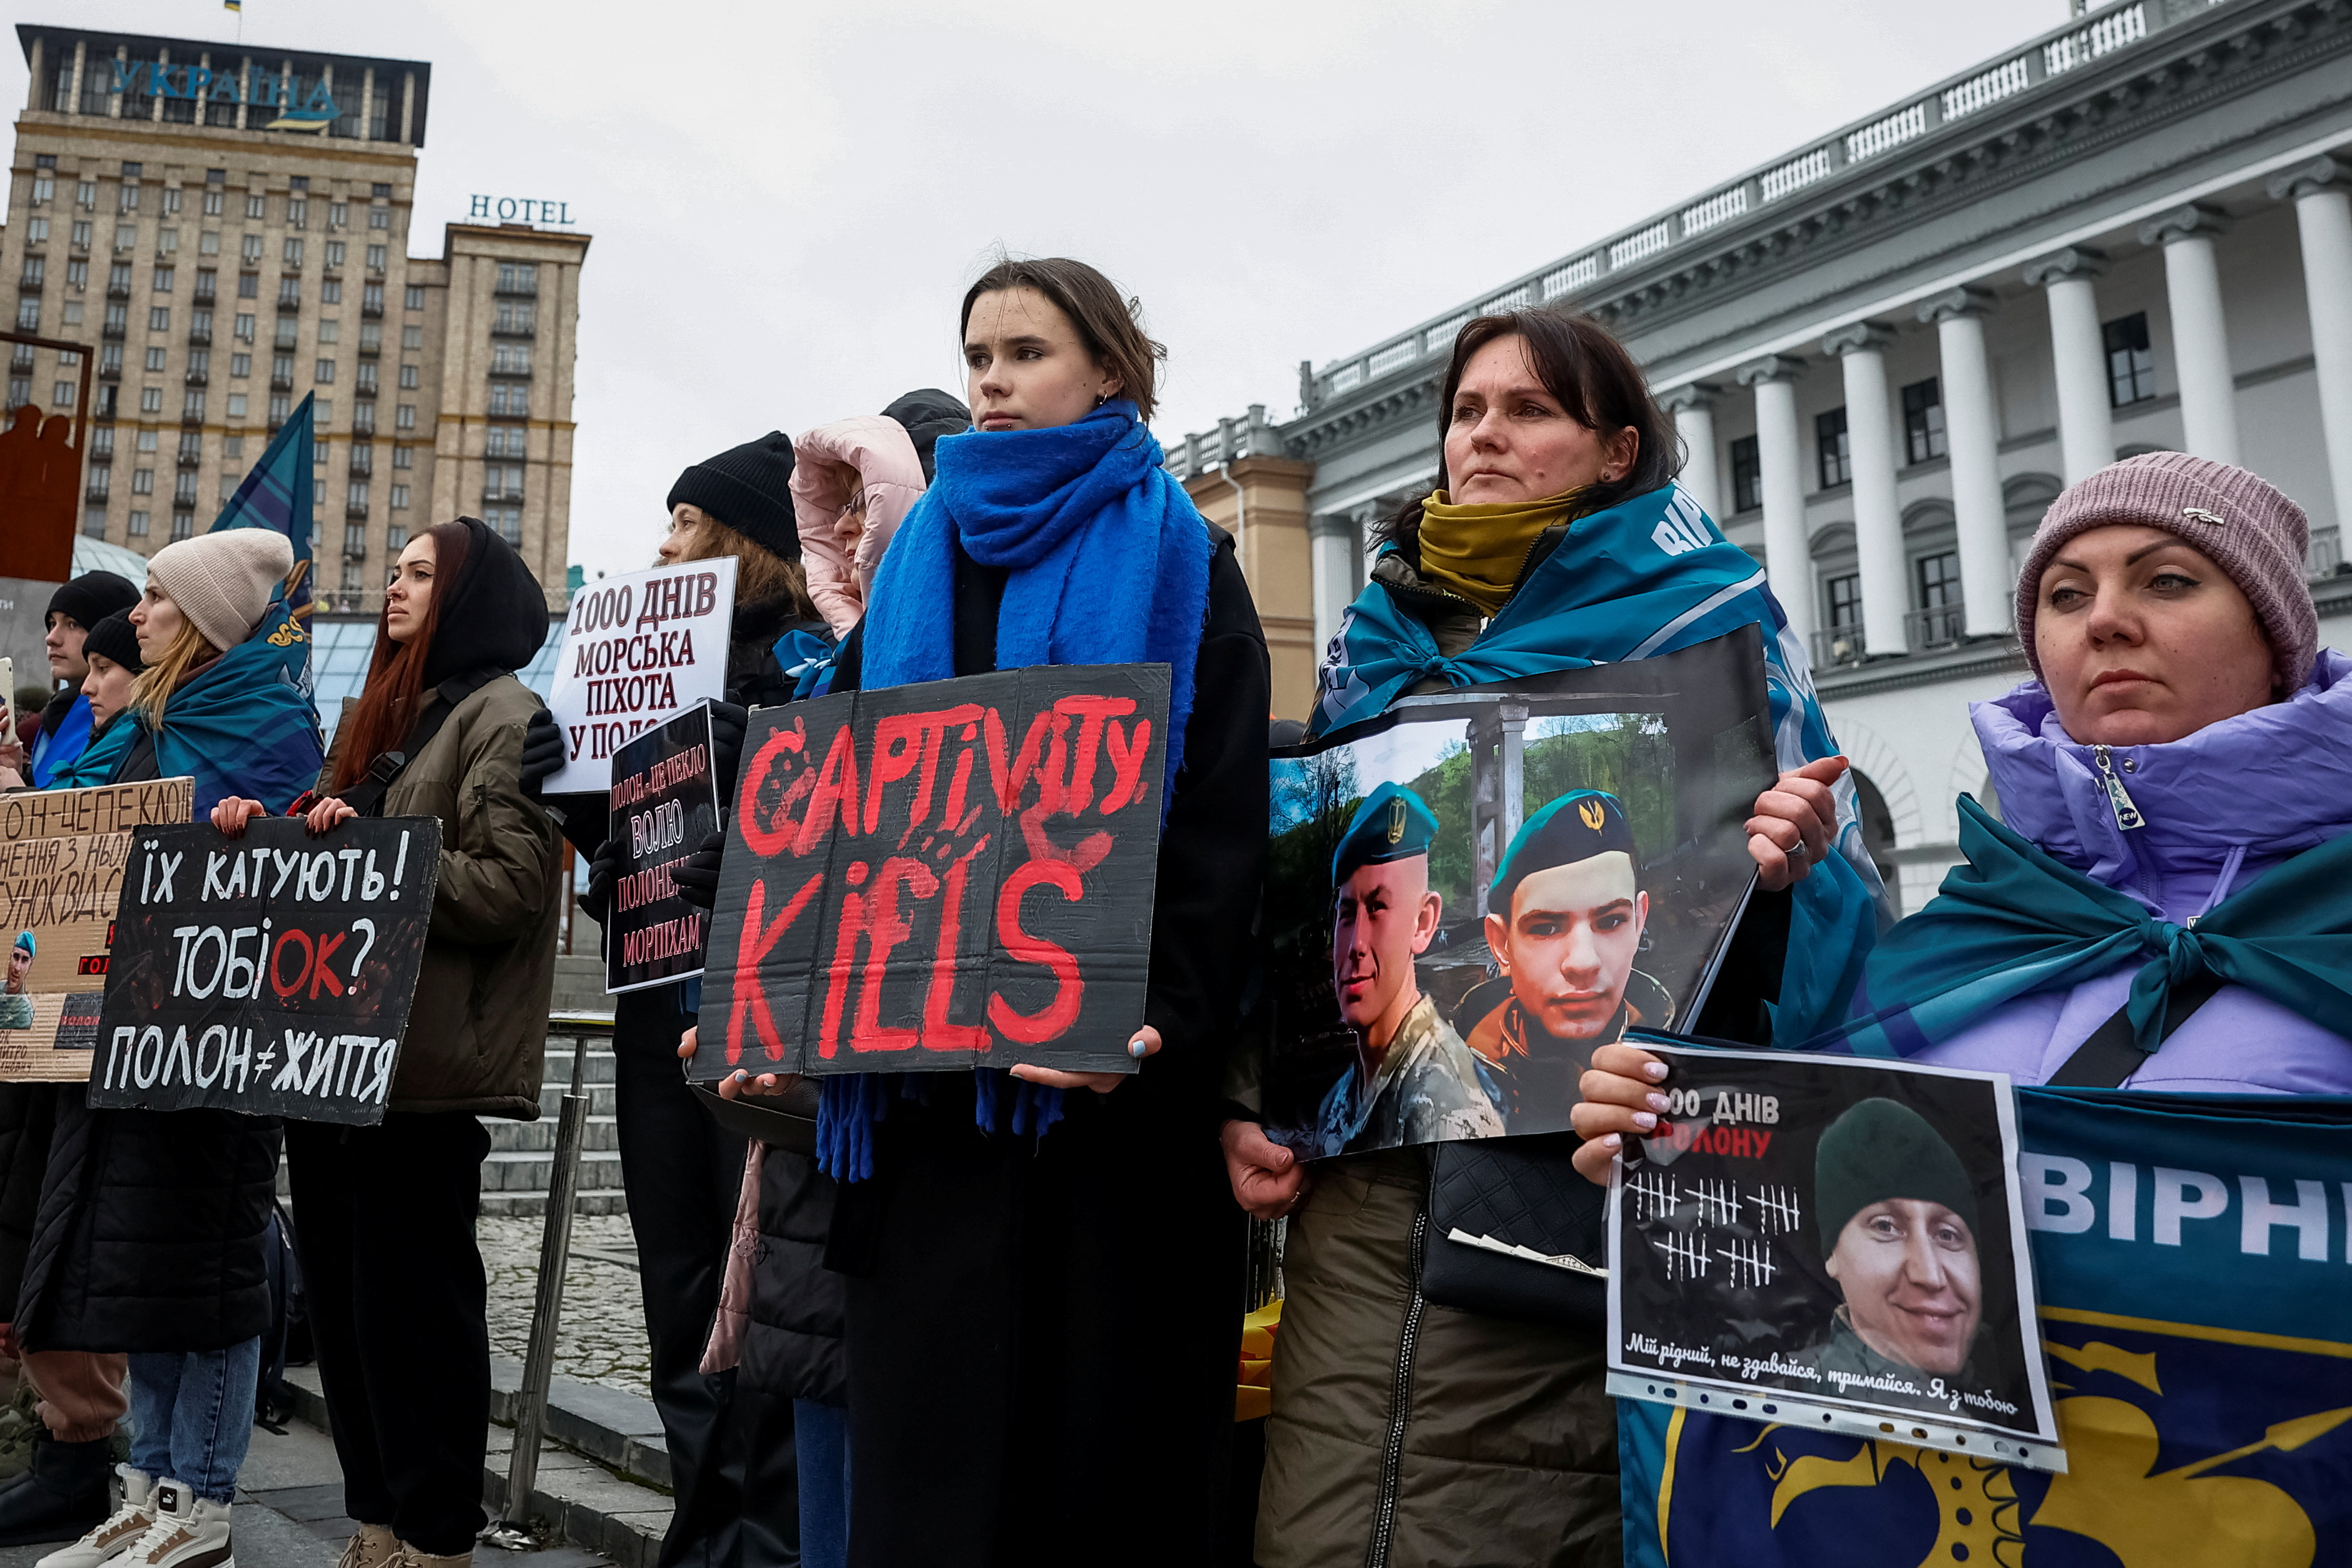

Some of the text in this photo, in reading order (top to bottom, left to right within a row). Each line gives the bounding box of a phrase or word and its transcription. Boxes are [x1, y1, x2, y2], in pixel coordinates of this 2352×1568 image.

[111, 58, 340, 112] УКРАЇНА
[470, 194, 577, 224] HOTEL
[1651, 478, 1714, 556] ВІР
[571, 573, 718, 636] 1000 ДНІВ
[574, 629, 695, 678] МОРСЬКА
[586, 671, 678, 716] ПІХОТА
[569, 724, 586, 761] У
[613, 772, 644, 812] ПОЛОН
[650, 761, 666, 797] ЦЕ
[666, 743, 706, 787] ПЕКЛО
[631, 798, 684, 859] ВОЛЮ
[2119, 812, 2137, 823] NEW
[140, 830, 410, 905] ЇХ КАТУЮТЬ!
[623, 912, 701, 967] МОРПІХАМ
[1713, 1091, 1779, 1125] ДНІВ
[1652, 1122, 1772, 1159] ПОЛОНУ
[1626, 1332, 2019, 1415] Мій рідний, не здавайся, тримайся. Я з тобою
